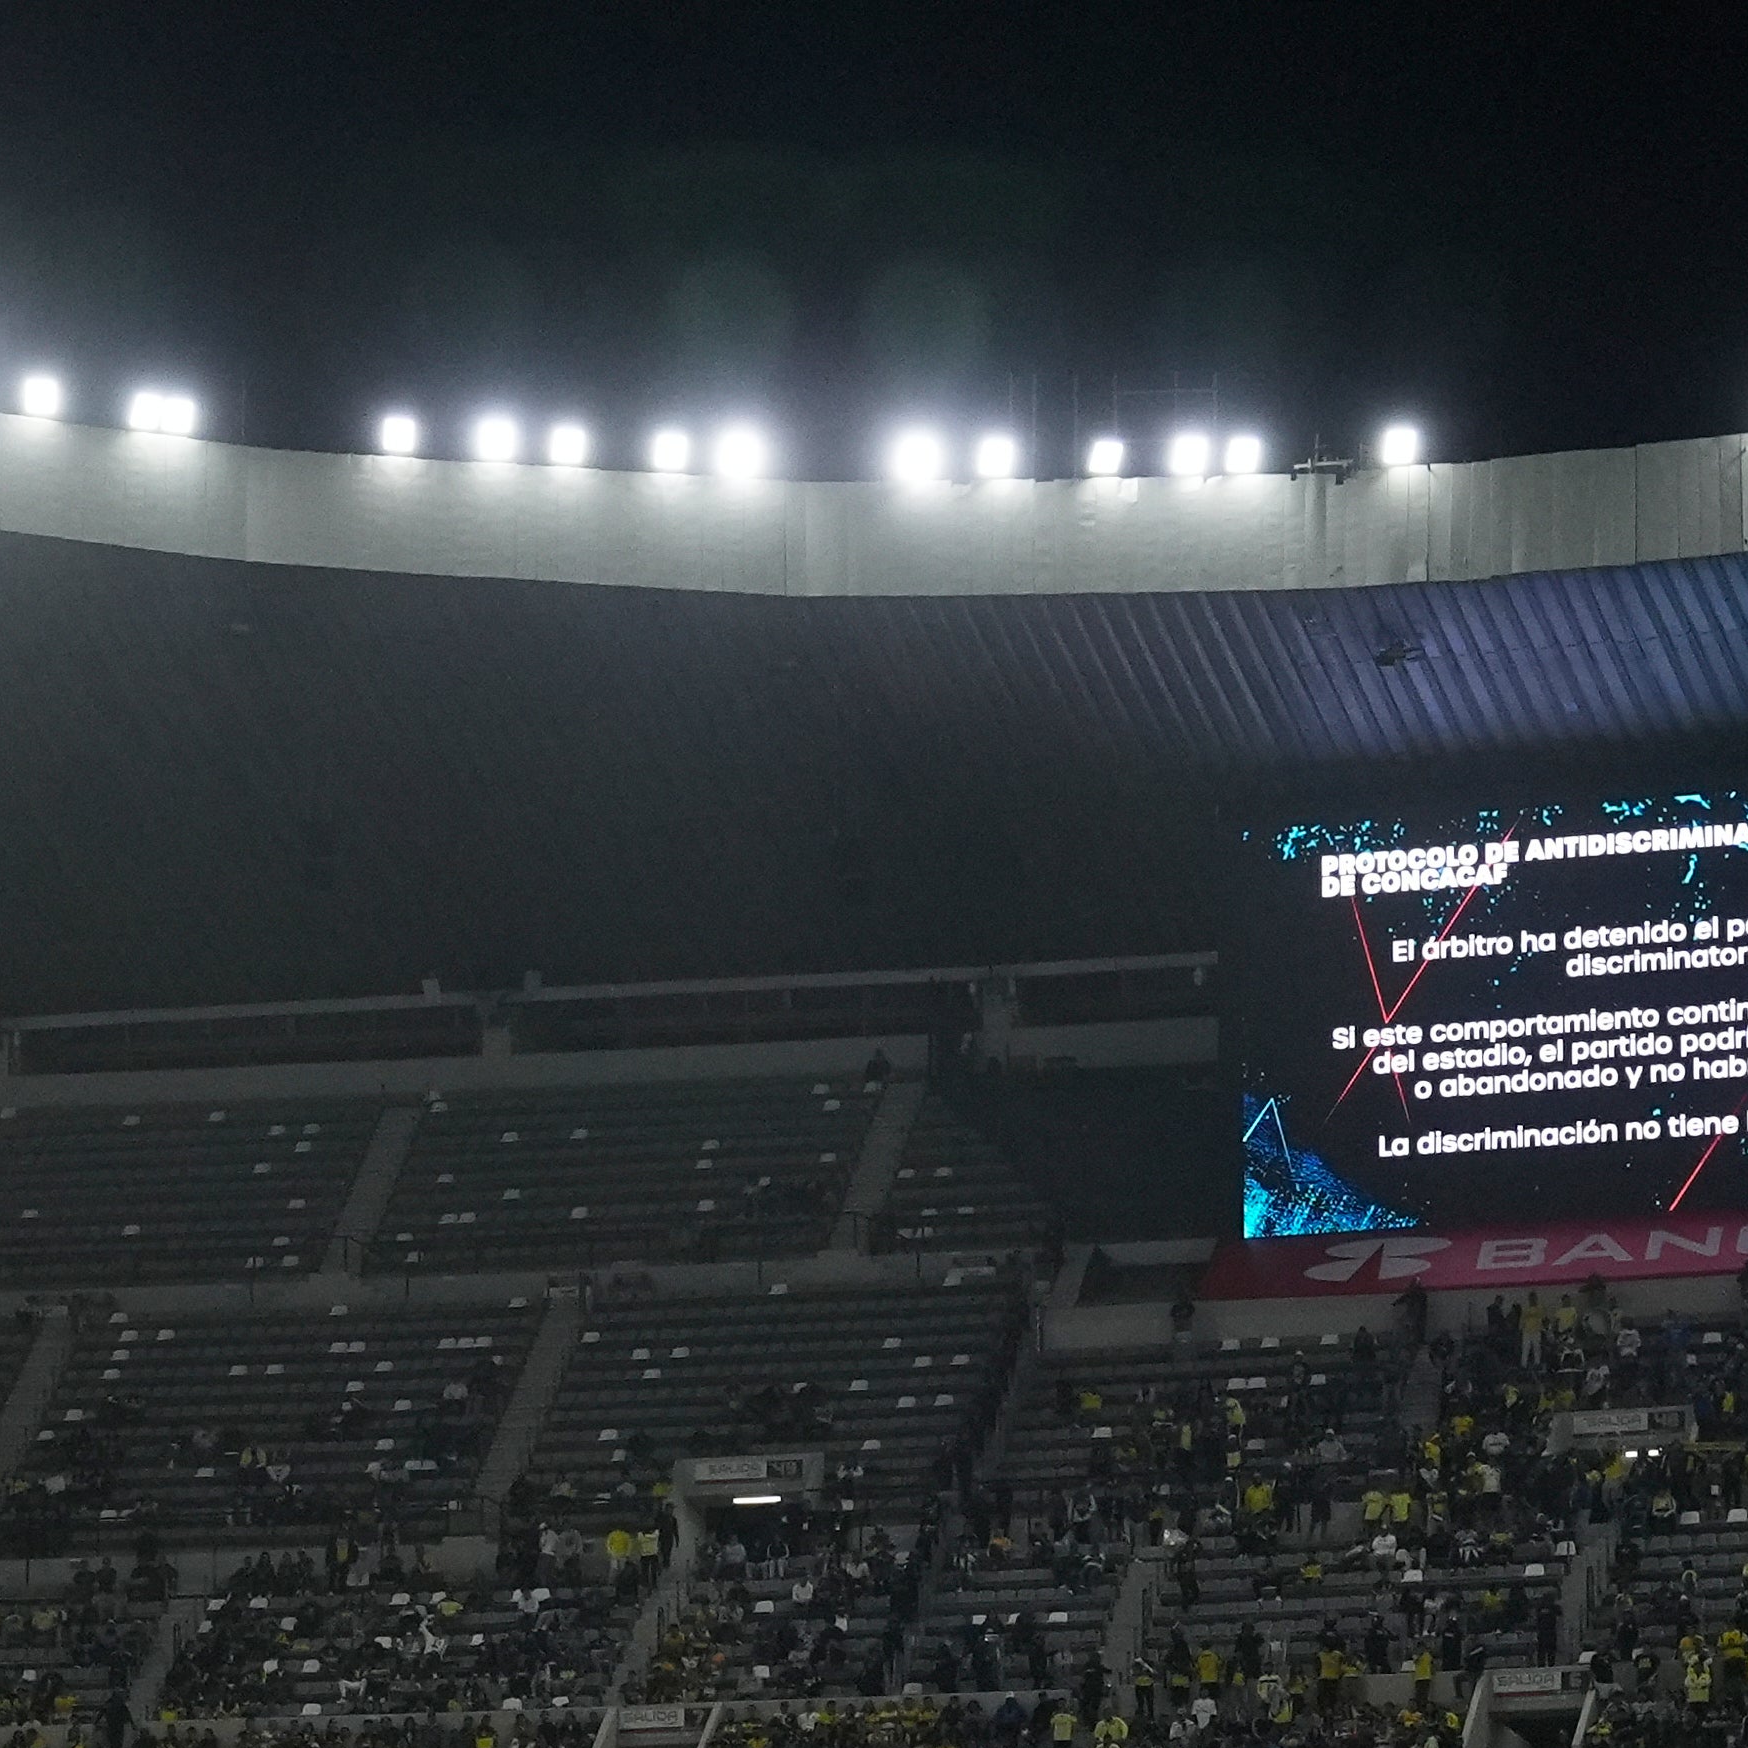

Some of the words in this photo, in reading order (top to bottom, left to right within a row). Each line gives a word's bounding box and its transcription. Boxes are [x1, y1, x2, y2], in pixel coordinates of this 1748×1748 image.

[1320, 844, 1479, 877] PROTOCOLO
[1484, 840, 1520, 865] DE
[1320, 874, 1356, 899] DE
[1361, 863, 1509, 896] CONCACAF
[1391, 940, 1415, 963] El
[1421, 929, 1514, 961] árbitro
[1520, 929, 1557, 954] ha
[1563, 920, 1688, 951] detenido
[1694, 916, 1720, 940] el
[1331, 1026, 1356, 1051] Si
[1362, 1023, 1423, 1048] este
[1429, 1006, 1660, 1044] comportamiento
[1372, 1052, 1415, 1076] del
[1422, 1041, 1533, 1073] estadio,
[1538, 1039, 1564, 1064] el
[1570, 1032, 1673, 1066] partido
[1413, 1079, 1433, 1101] o
[1438, 1064, 1619, 1099] abandonado
[1624, 1064, 1644, 1090] y
[1649, 1061, 1686, 1084] no
[1378, 1134, 1411, 1159] La
[1416, 1118, 1619, 1155] discriminación
[1624, 1118, 1661, 1143] no
[1667, 1111, 1740, 1139] tiene
